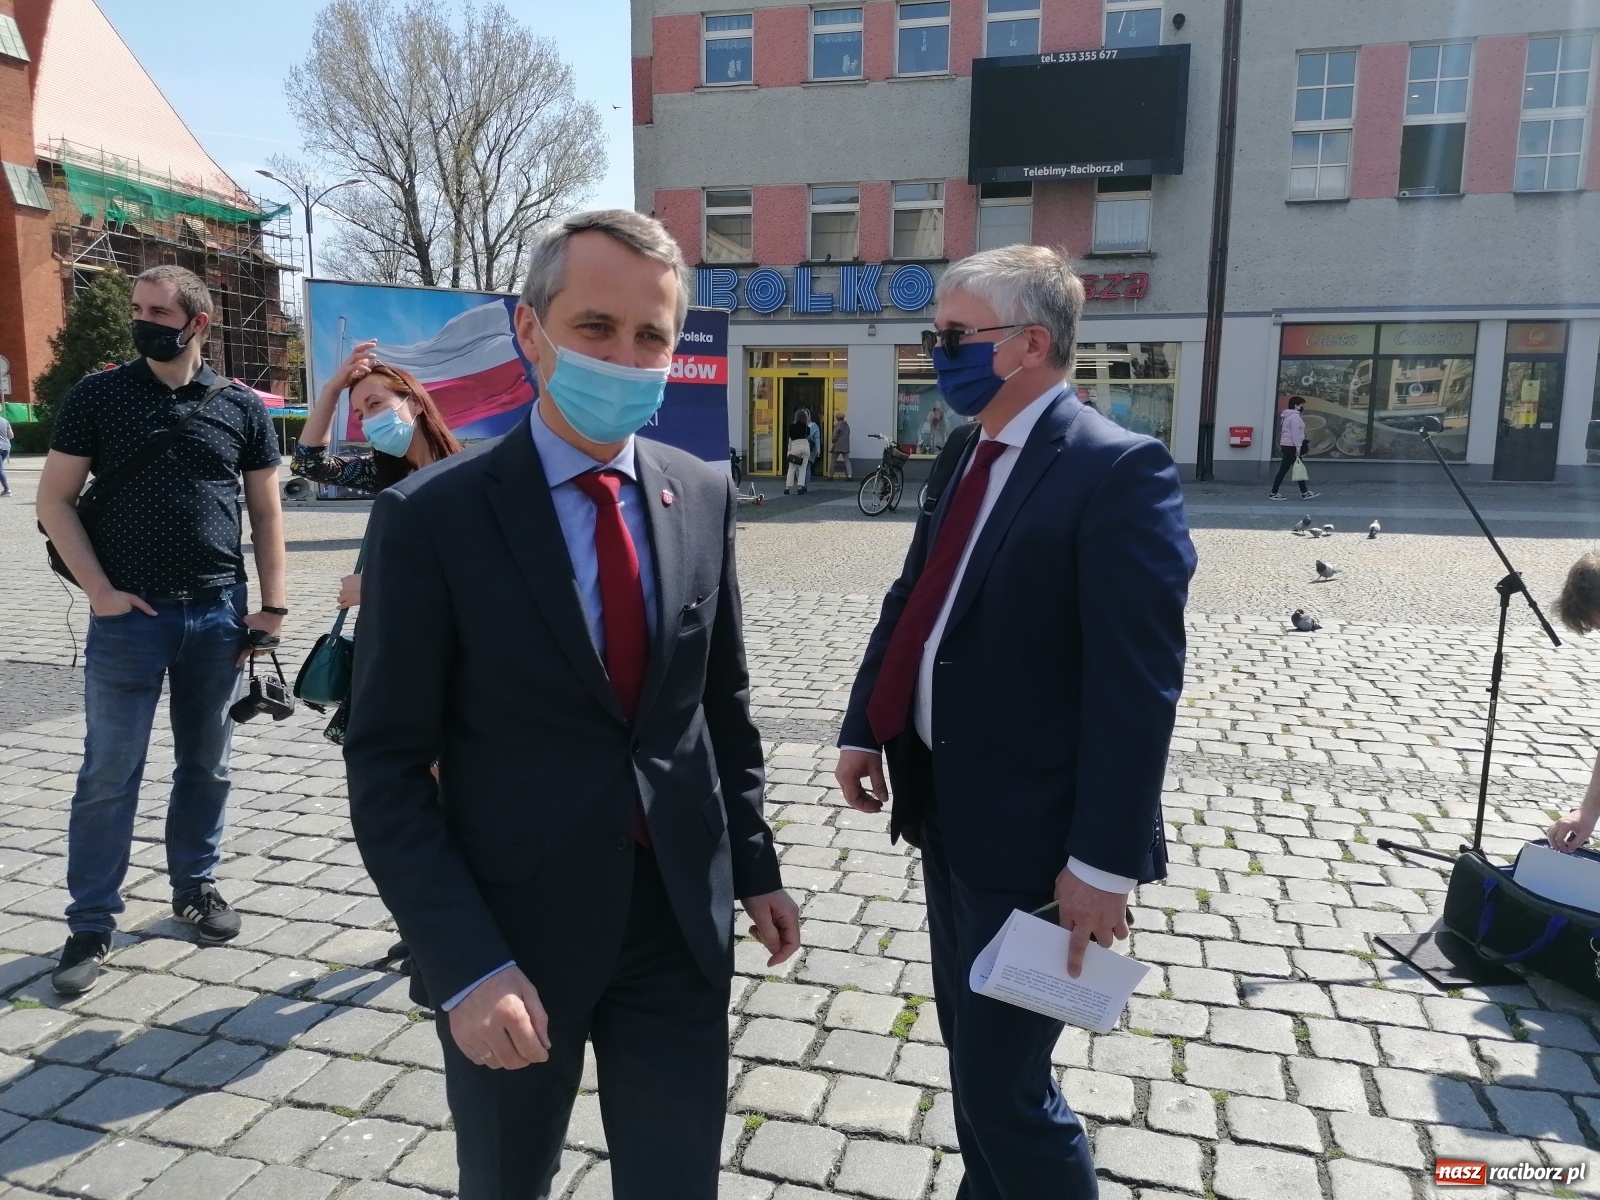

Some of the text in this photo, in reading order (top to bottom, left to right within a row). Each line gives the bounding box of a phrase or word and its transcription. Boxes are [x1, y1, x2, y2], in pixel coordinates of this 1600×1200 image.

[1041, 50, 1118, 63] tel. 533 355 677
[1023, 162, 1124, 177] Telebimy-Raciborz.pl
[696, 264, 934, 313] BOLKO
[679, 331, 714, 343] Polska
[1305, 332, 1358, 347] Ciasta
[670, 356, 717, 380] dów
